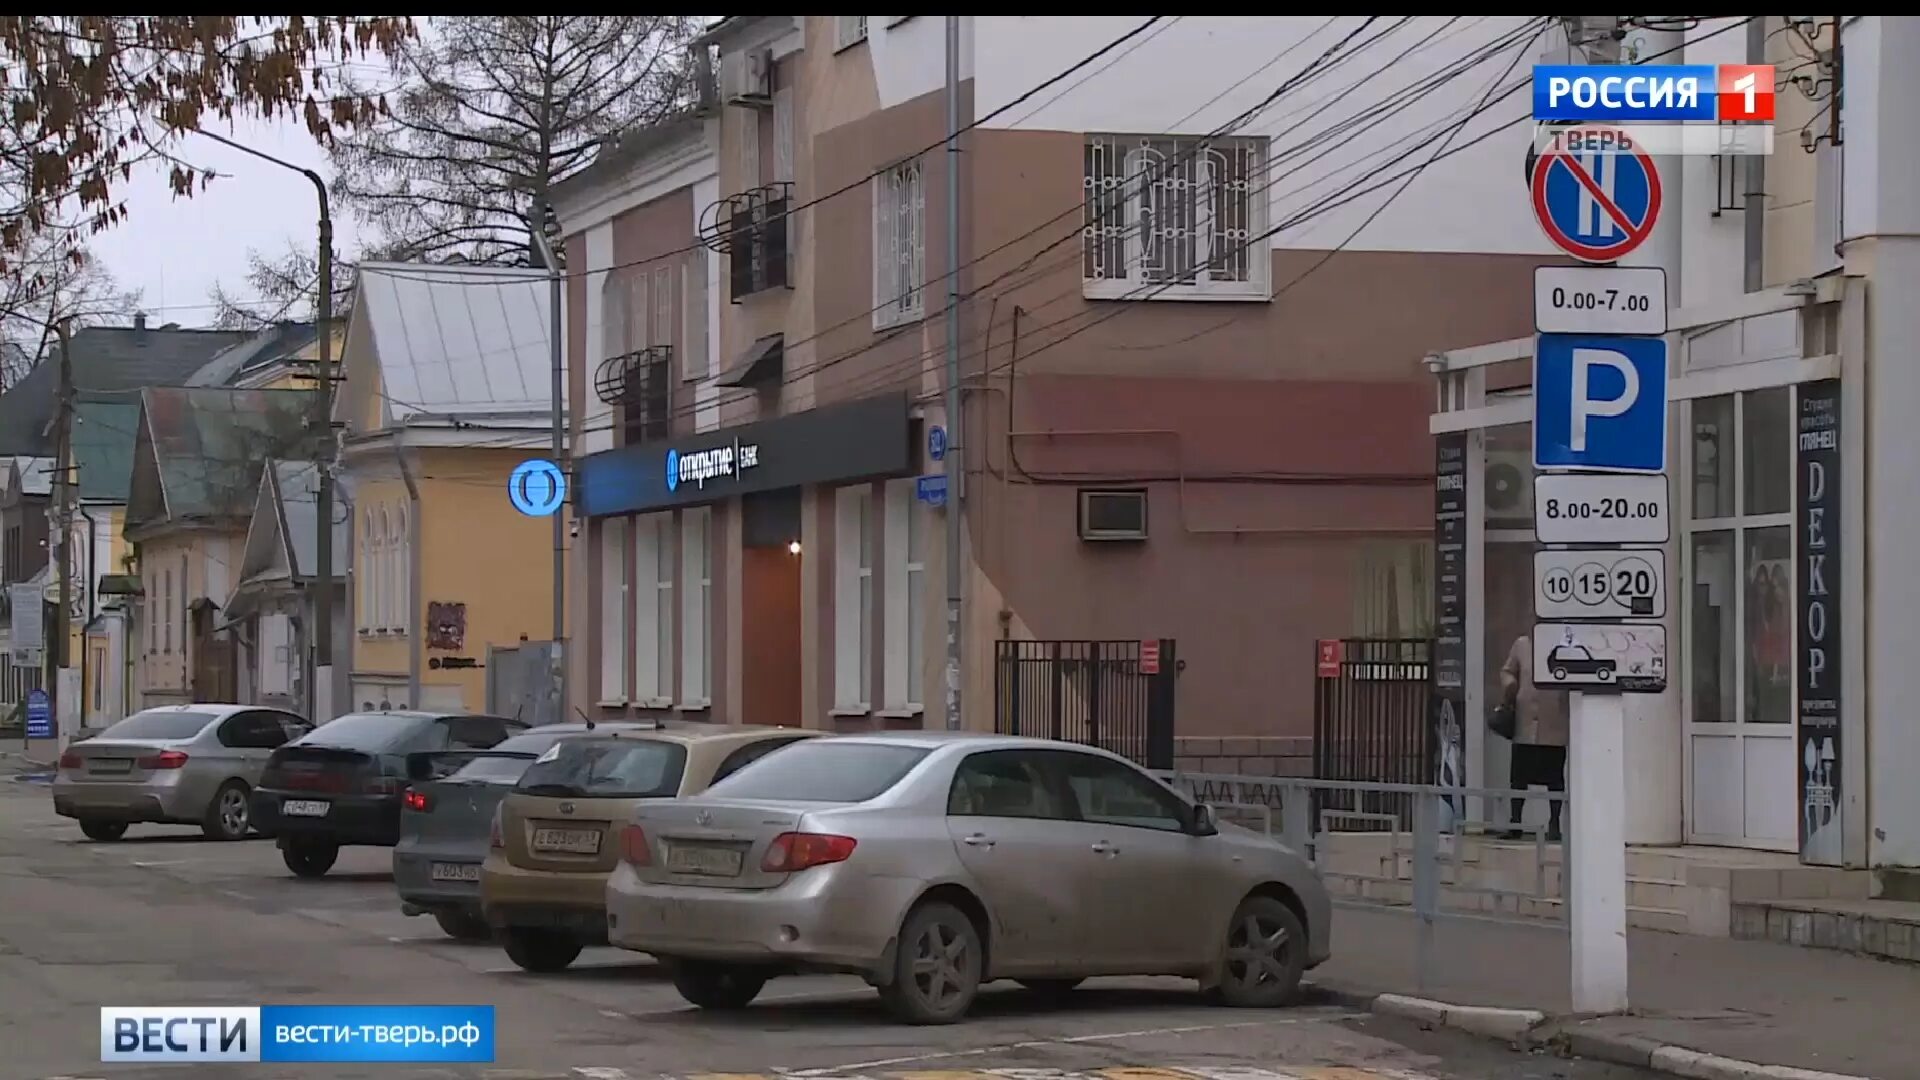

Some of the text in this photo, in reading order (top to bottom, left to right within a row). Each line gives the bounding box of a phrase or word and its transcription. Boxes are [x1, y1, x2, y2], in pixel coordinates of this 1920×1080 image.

[1552, 287, 1649, 312] 0.00-7.00
[1570, 348, 1640, 452] P
[1546, 498, 1658, 519] 8.00-20.00
[1547, 570, 1650, 596] 10 15 20
